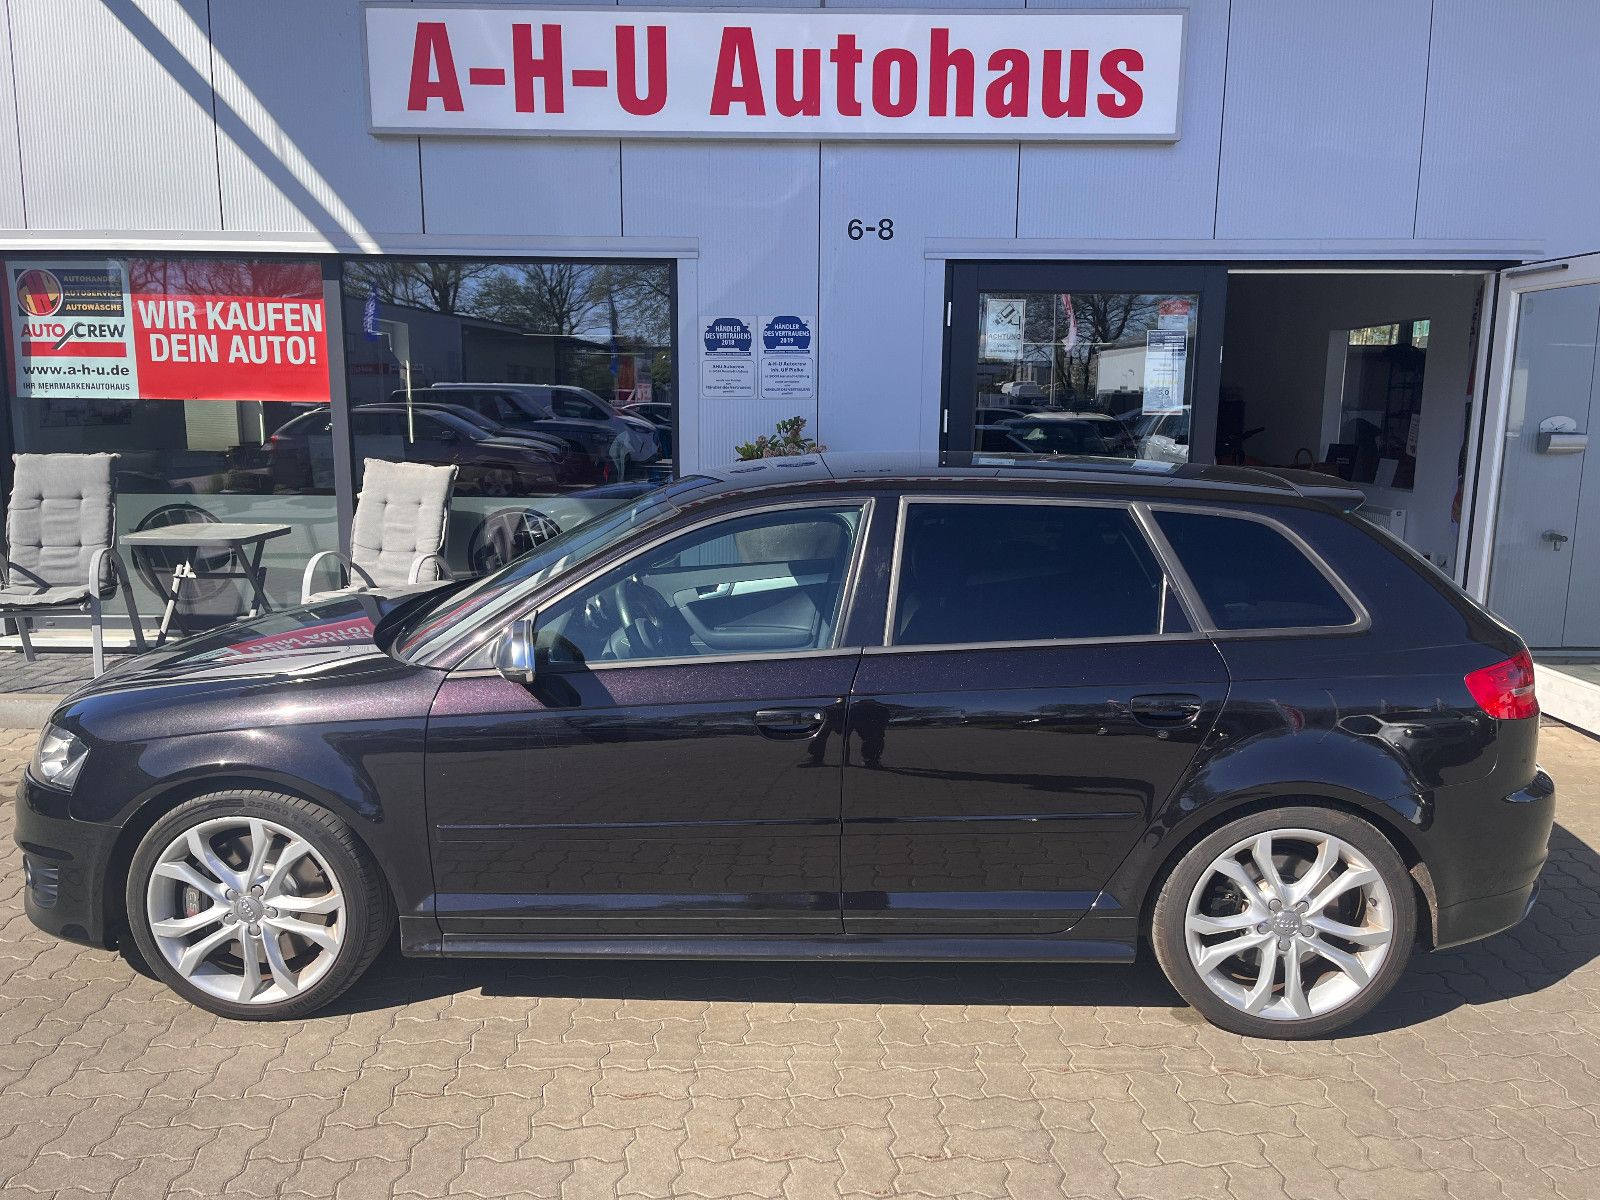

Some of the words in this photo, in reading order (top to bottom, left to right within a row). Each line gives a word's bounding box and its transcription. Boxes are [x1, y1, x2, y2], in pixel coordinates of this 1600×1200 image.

[407, 22, 667, 116] A-H-U
[710, 26, 1144, 119] Autohaus
[847, 218, 895, 241] 6-8
[64, 288, 122, 297] AUTOSERVICE
[66, 302, 122, 312] AUTOWÄSCHE
[138, 300, 204, 331] WIR
[207, 301, 323, 333] KAUFEN
[21, 323, 66, 338] AUTO
[73, 323, 126, 338] CREW
[705, 332, 716, 340] DES
[716, 332, 751, 340] VERTRAUENS
[150, 333, 220, 363] DEIN
[228, 335, 317, 365] AUTO!
[23, 364, 130, 376] www.a-h-u.de
[23, 382, 36, 391] IHR
[38, 382, 130, 391] MEHRMARKENAUTOHAUS
